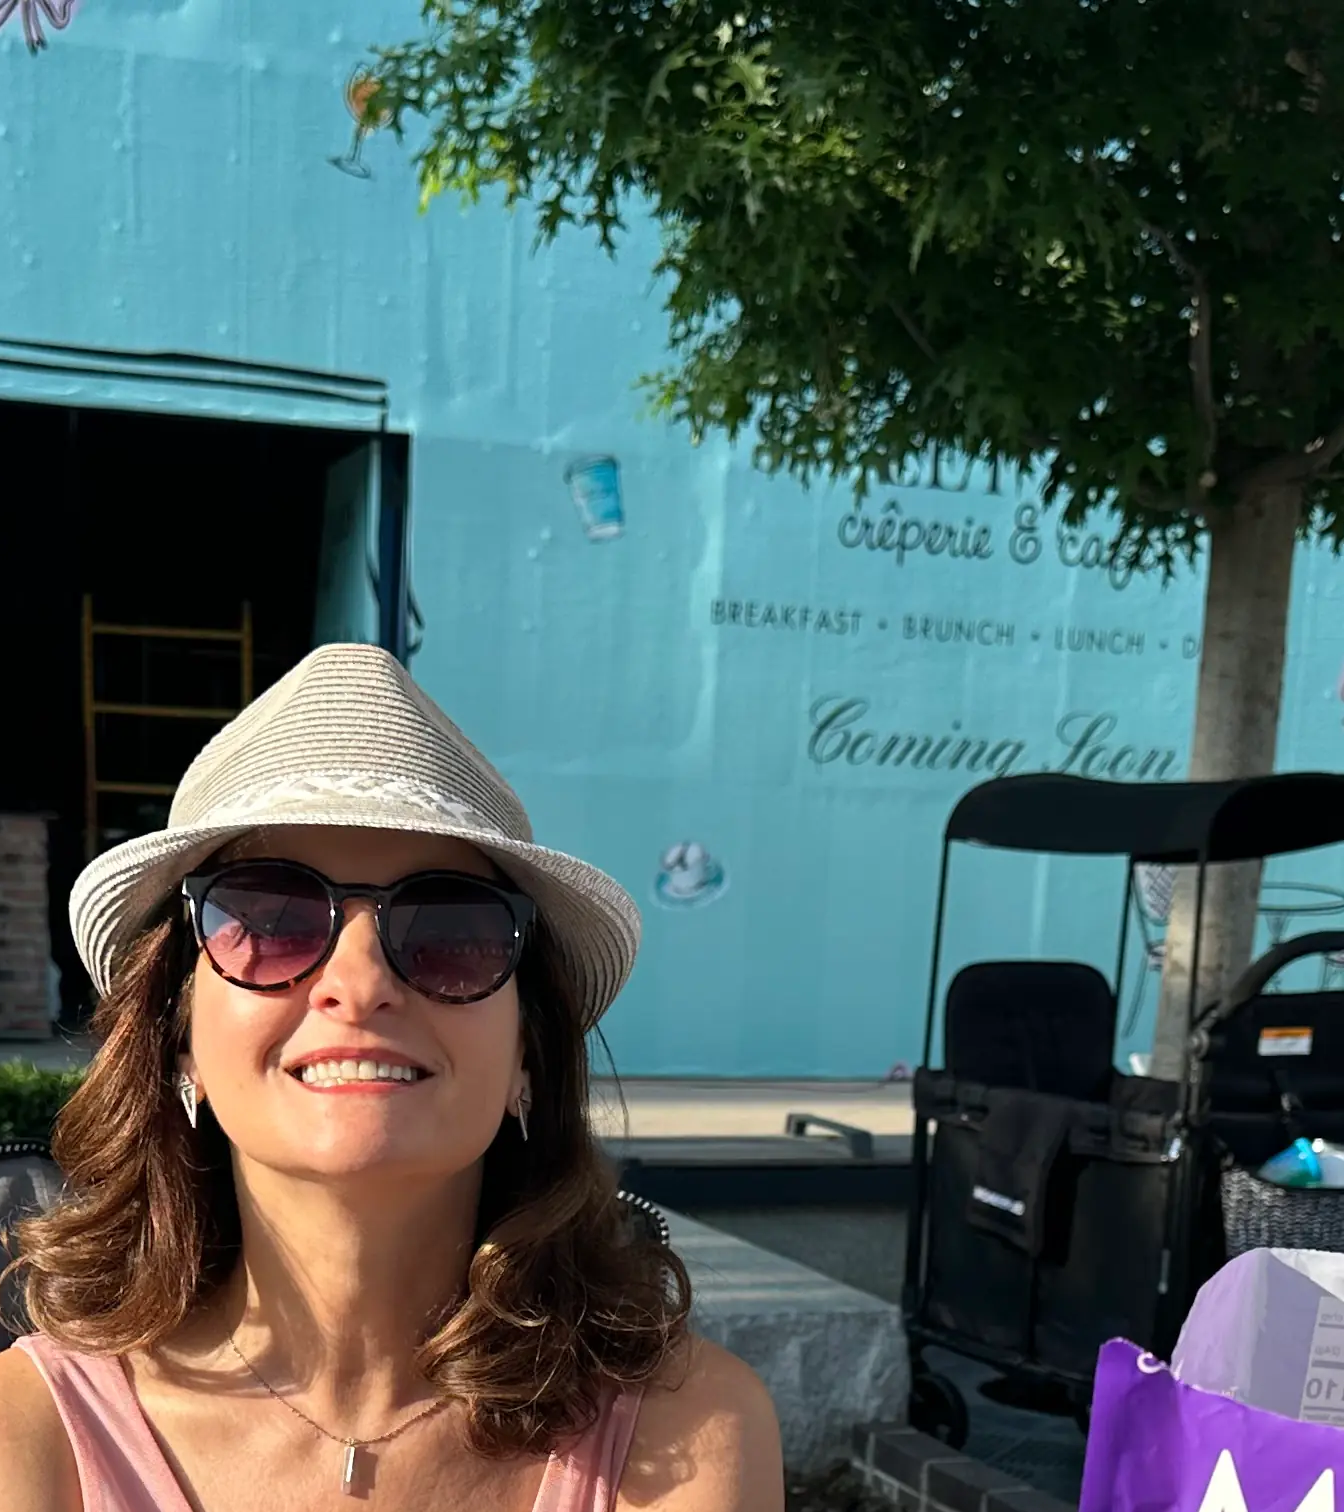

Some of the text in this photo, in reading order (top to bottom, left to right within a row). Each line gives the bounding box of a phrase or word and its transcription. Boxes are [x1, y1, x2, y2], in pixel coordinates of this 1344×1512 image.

[1009, 502, 1042, 565] &
[711, 598, 864, 637] BREAKFAST
[902, 614, 1015, 647] BRUNCH
[1053, 627, 1146, 656] LUNCH
[805, 695, 1029, 779] Coming
